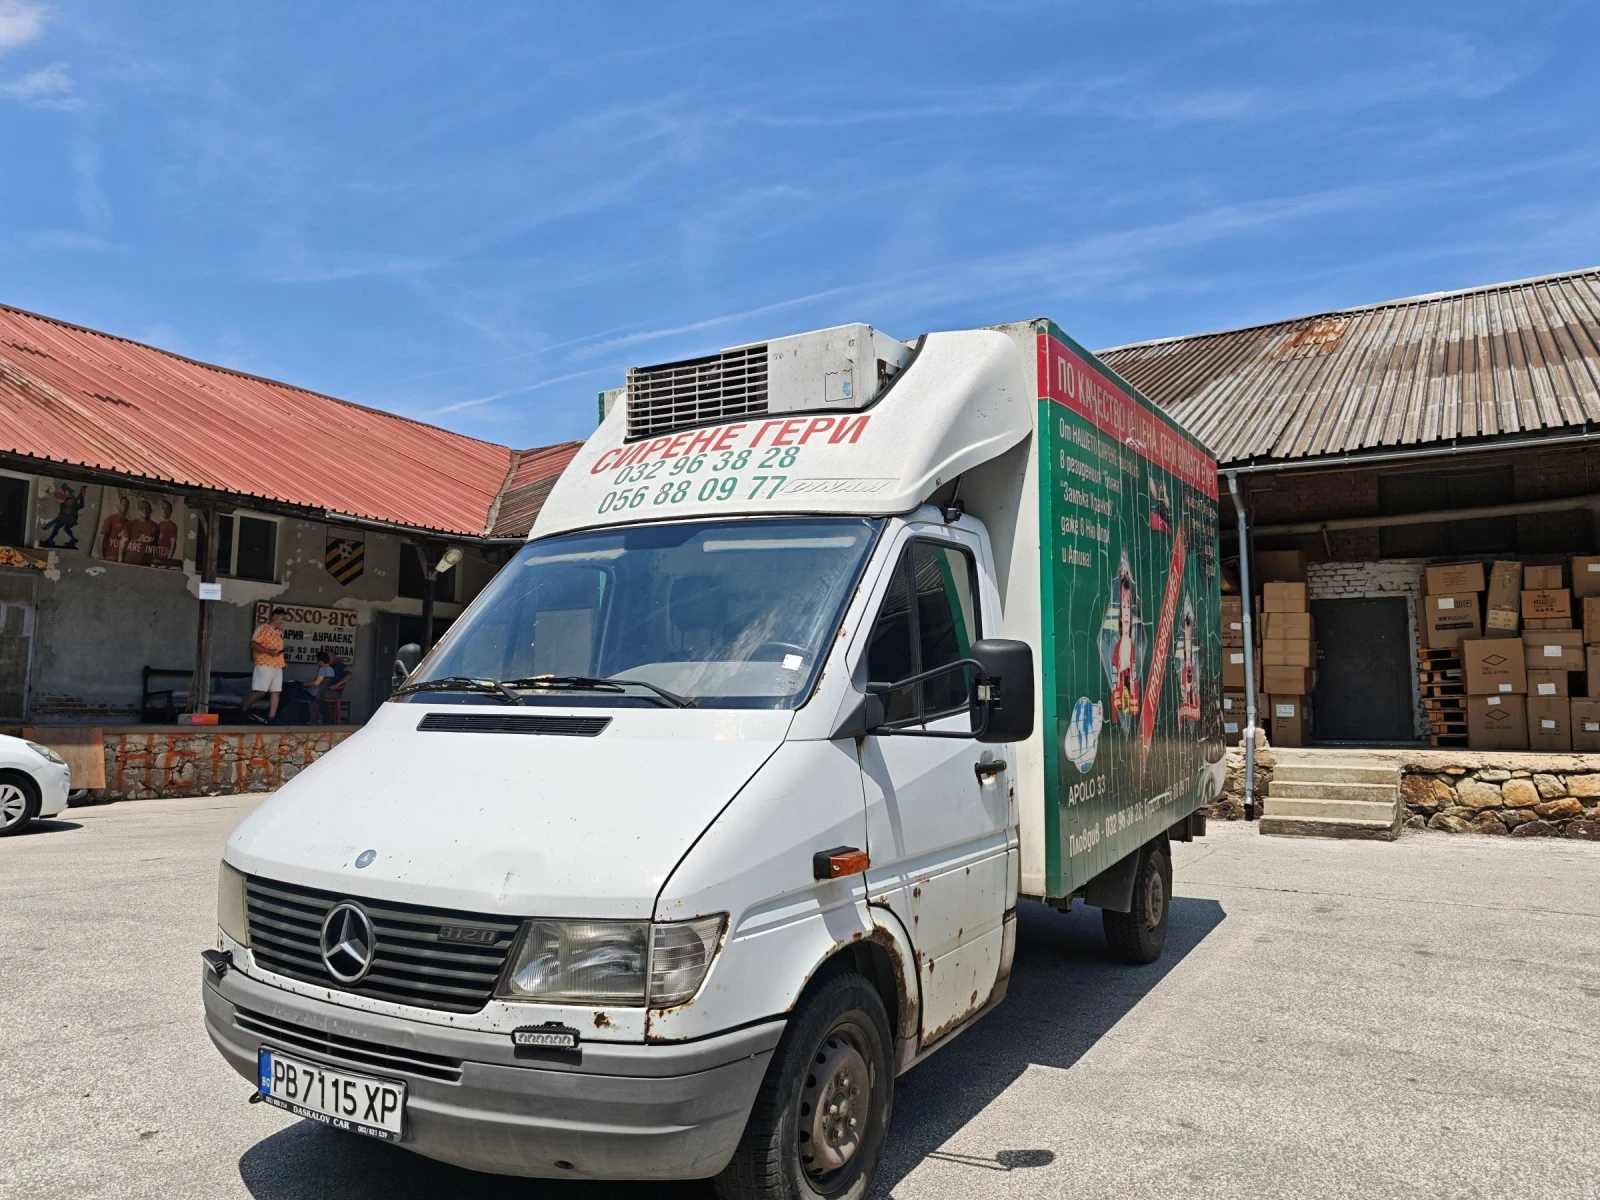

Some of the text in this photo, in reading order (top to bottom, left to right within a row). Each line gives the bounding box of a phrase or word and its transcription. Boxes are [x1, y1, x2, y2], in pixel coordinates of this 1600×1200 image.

[1058, 355, 1075, 399] ПО
[1078, 369, 1126, 433] КАЧЕСТВО
[1161, 431, 1177, 467] ГЕРИ
[590, 415, 872, 475] СИРЕНЕ ГЕРИ
[1072, 423, 1098, 455] НАШЕТО
[613, 446, 801, 486] 032 96 38 28
[598, 475, 788, 515] 056 88 09 77
[127, 541, 142, 553] ARE
[145, 545, 169, 556] INVITED
[281, 629, 353, 644] АРИЯ ДУРАЛЕКС
[320, 644, 354, 657] АРКОПАЛ
[117, 732, 197, 797] НЕ
[1068, 774, 1106, 808] APOLO 33
[1069, 822, 1100, 858] Пловдив
[1105, 813, 1117, 838] 032
[1118, 809, 1126, 831] 96
[1127, 805, 1134, 827] 38
[439, 925, 478, 941] 312
[261, 1076, 271, 1088] BG
[293, 1105, 331, 1124] DASKALOV
[333, 1118, 350, 1130] CAR
